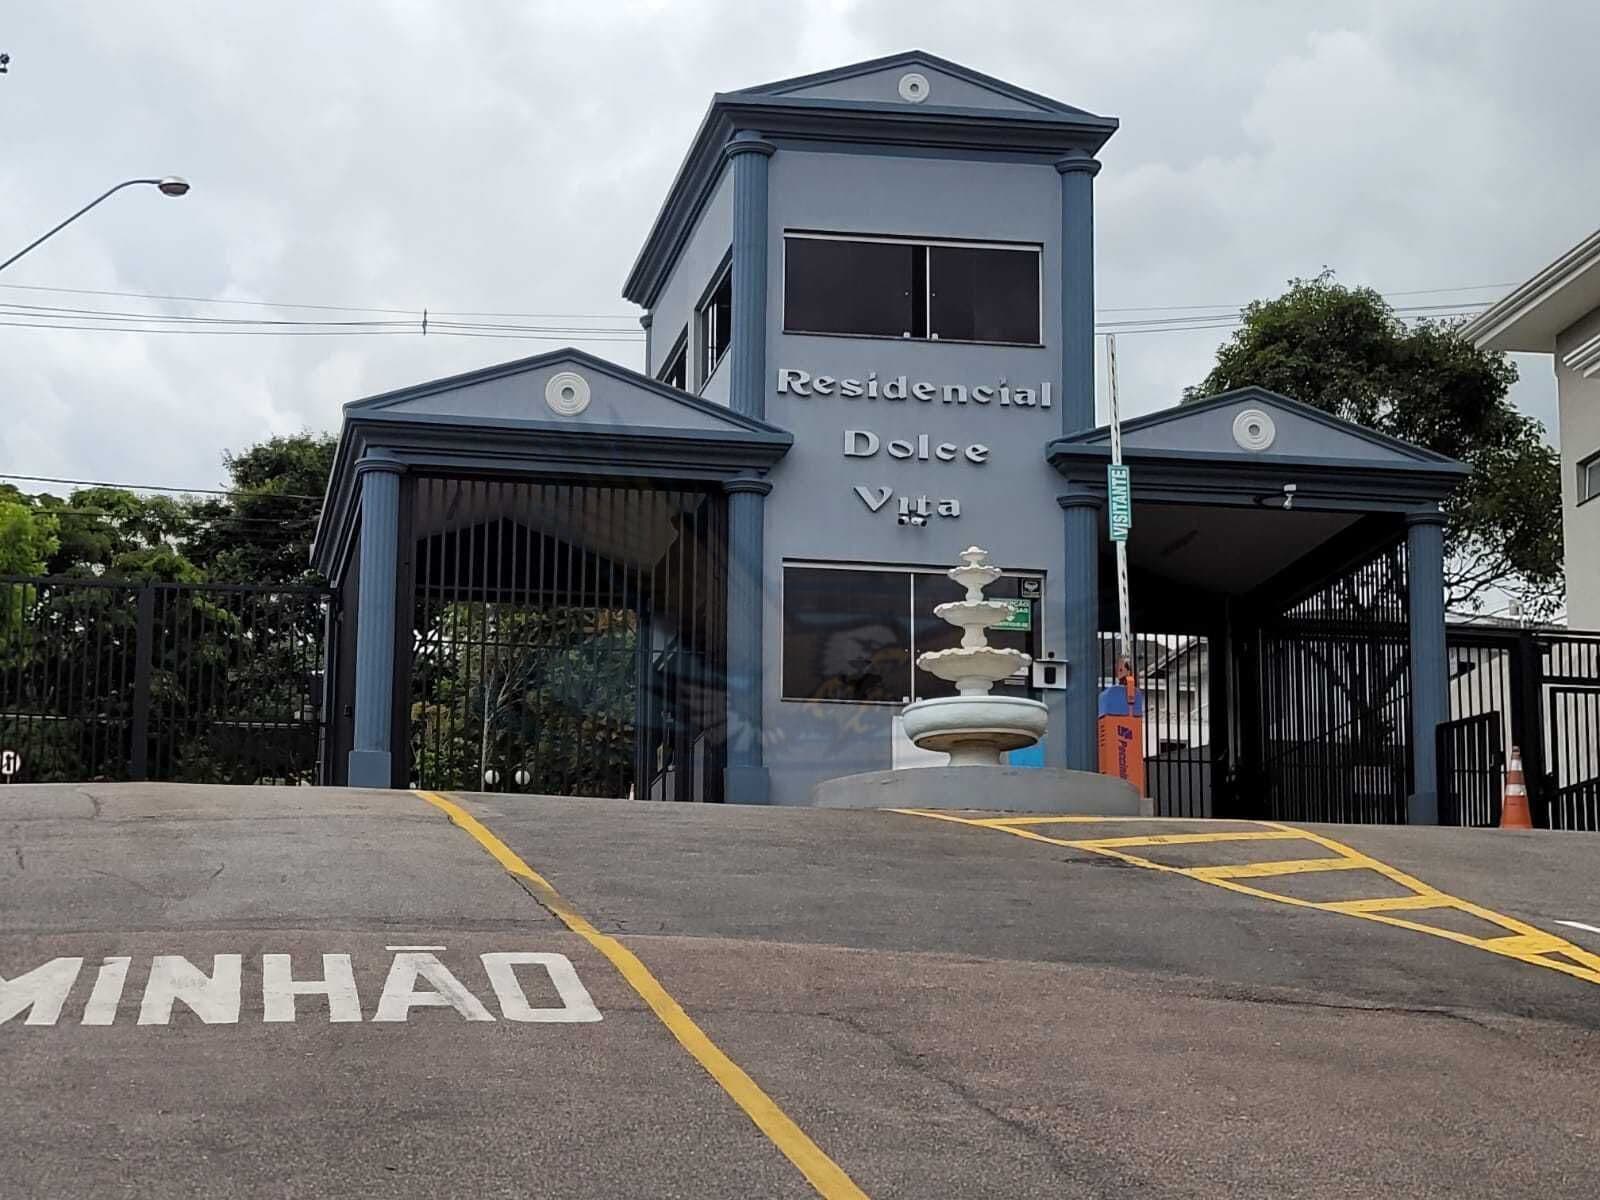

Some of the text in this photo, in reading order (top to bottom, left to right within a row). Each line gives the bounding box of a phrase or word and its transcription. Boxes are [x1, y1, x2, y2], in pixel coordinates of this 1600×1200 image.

[777, 368, 1052, 408] Residencial
[843, 430, 990, 463] Dolce
[853, 485, 961, 518] Vita
[1111, 469, 1129, 536] VISITANTE
